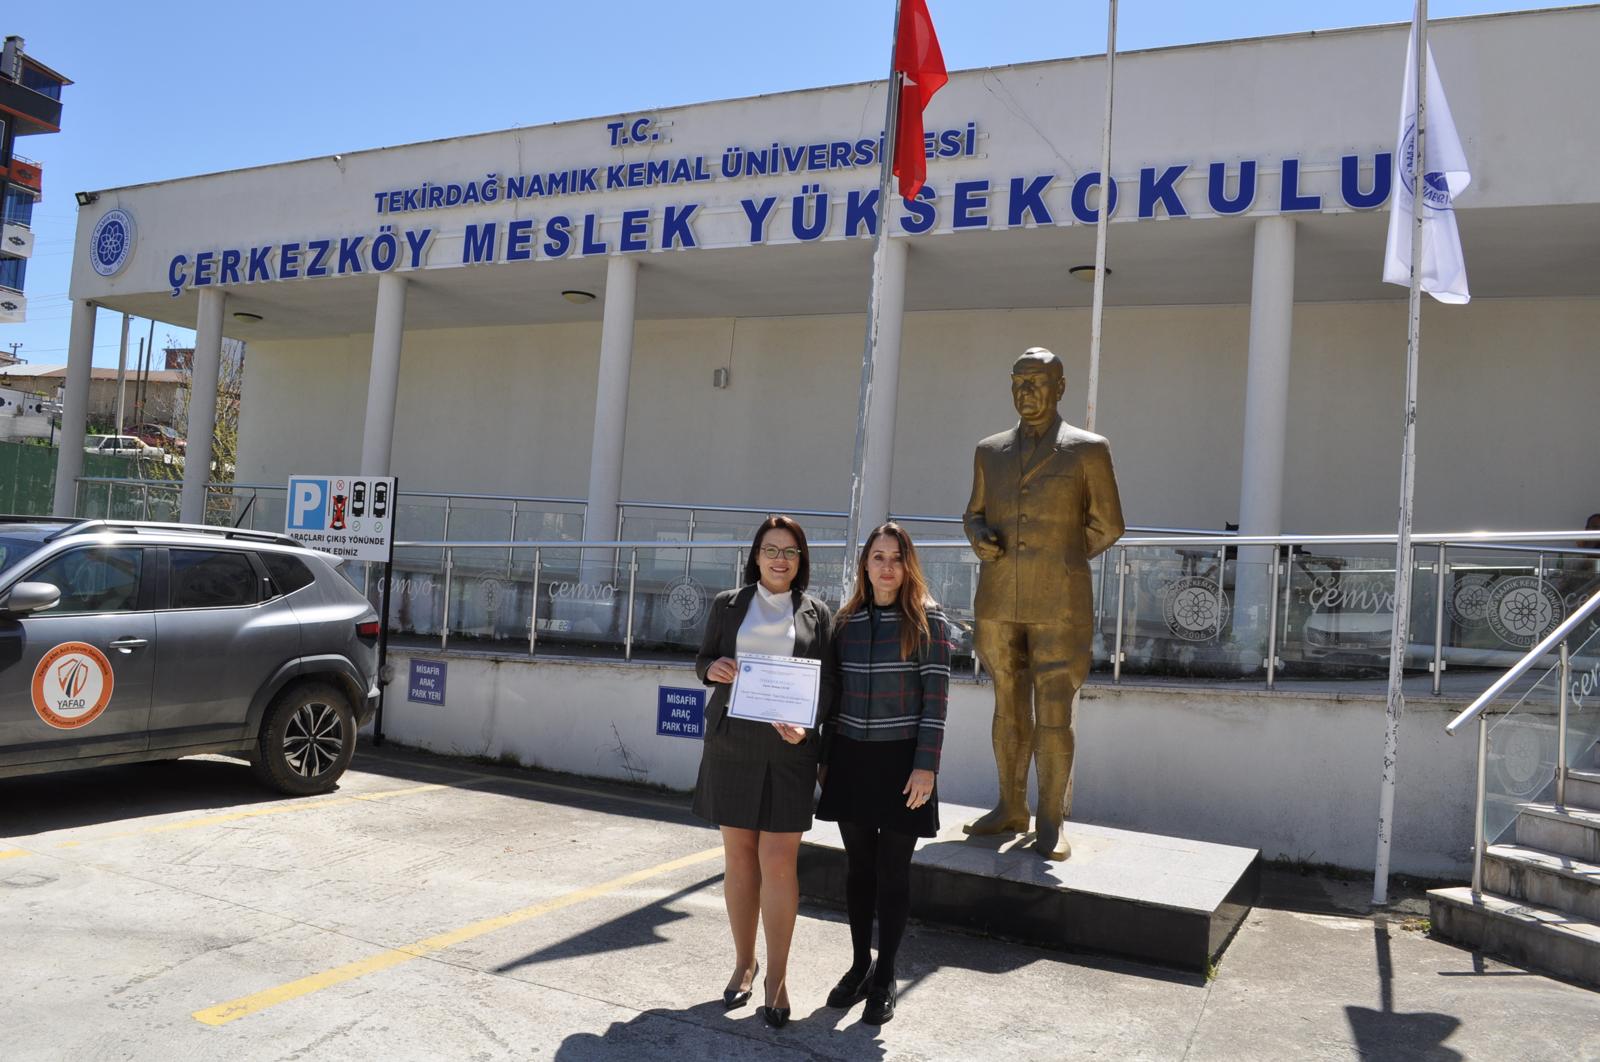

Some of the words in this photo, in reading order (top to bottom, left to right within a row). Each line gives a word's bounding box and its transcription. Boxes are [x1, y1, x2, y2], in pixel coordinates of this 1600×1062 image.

[607, 118, 659, 146] T.C.
[374, 173, 498, 213] TEKİRDAĞ
[506, 167, 598, 200] NAMIK
[606, 156, 711, 189] KEMAL
[721, 121, 976, 178] ÜNİVERSİESİ
[168, 225, 432, 297] ÇERKEZKÖY
[462, 203, 698, 264] MESLEK
[740, 152, 1392, 243] YÜKSEKOKULU
[293, 482, 322, 527] P
[326, 535, 347, 546] ÇIKIŞ
[348, 535, 385, 546] YÖNÜNDE
[420, 677, 435, 689] ARAÇ
[57, 699, 86, 708] YAFAD
[666, 692, 697, 706] MİSAFİR
[671, 708, 691, 721] ARAÇ
[662, 721, 681, 731] PARK
[682, 722, 699, 734] YERİ
